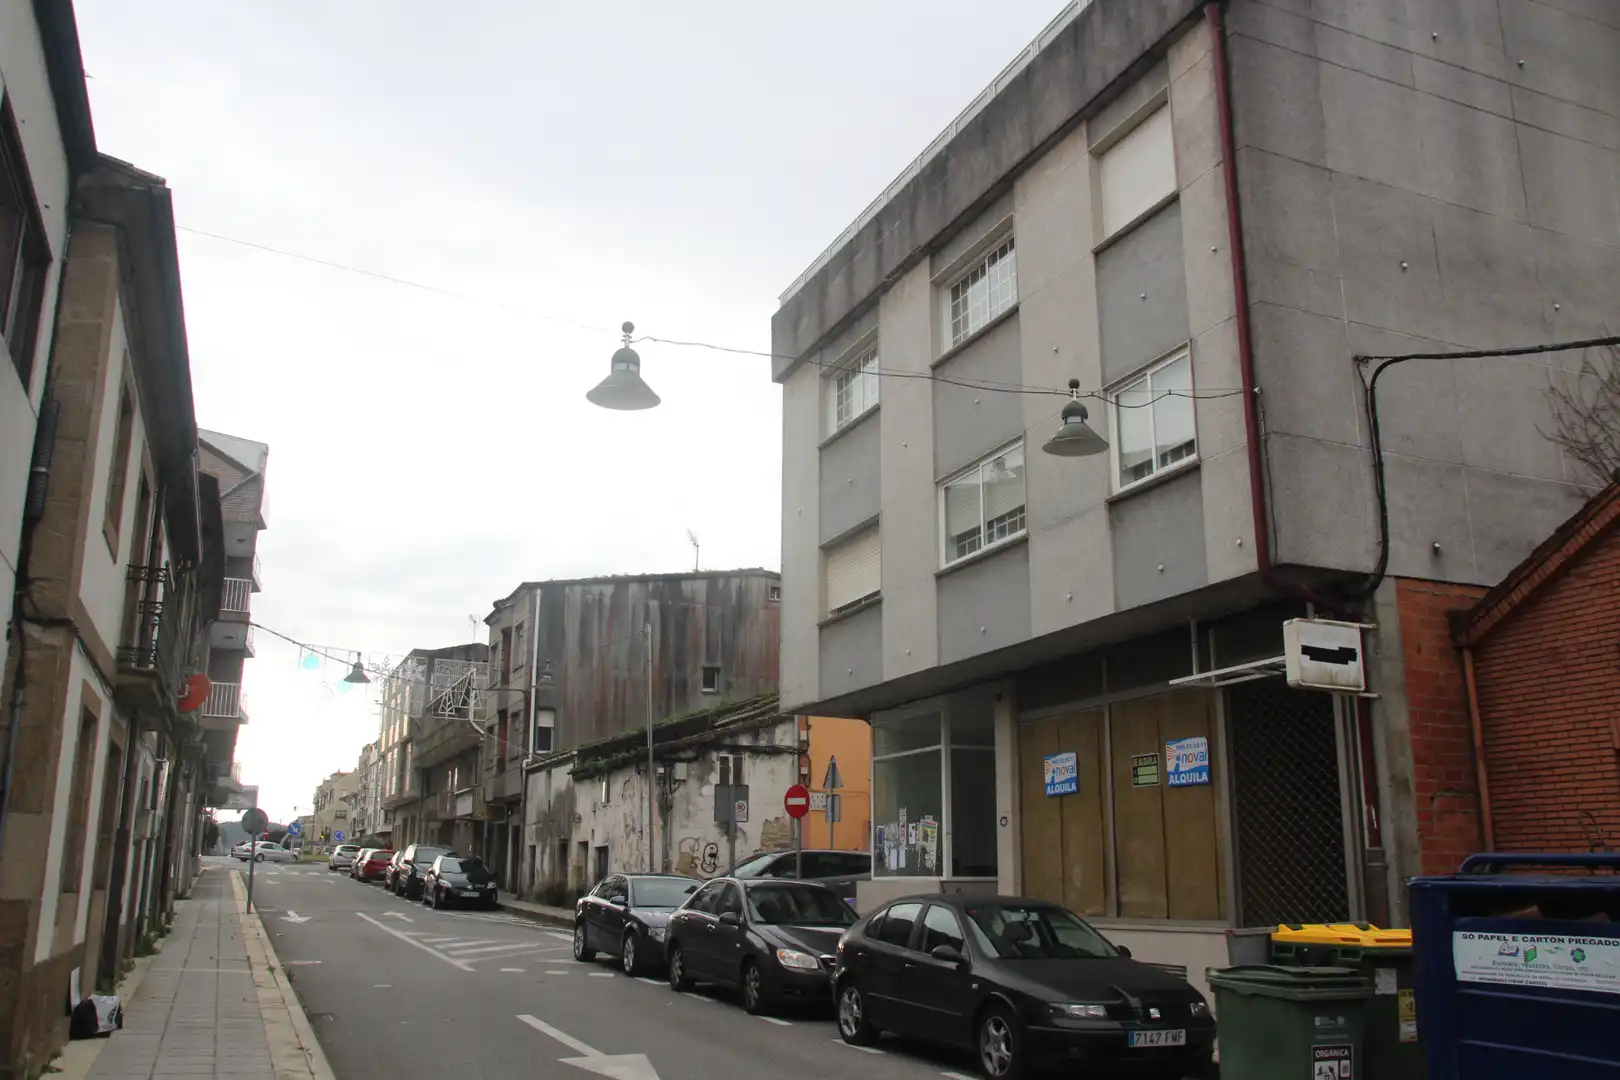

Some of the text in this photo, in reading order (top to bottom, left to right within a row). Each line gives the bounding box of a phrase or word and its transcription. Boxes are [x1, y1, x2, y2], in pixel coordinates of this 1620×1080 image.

[1168, 771, 1208, 785] ALQUILA
[1046, 782, 1077, 795] ALQUILA
[1478, 934, 1509, 942] PAPEL
[1568, 937, 1620, 946] PREGADO
[1135, 1032, 1163, 1045] 7147
